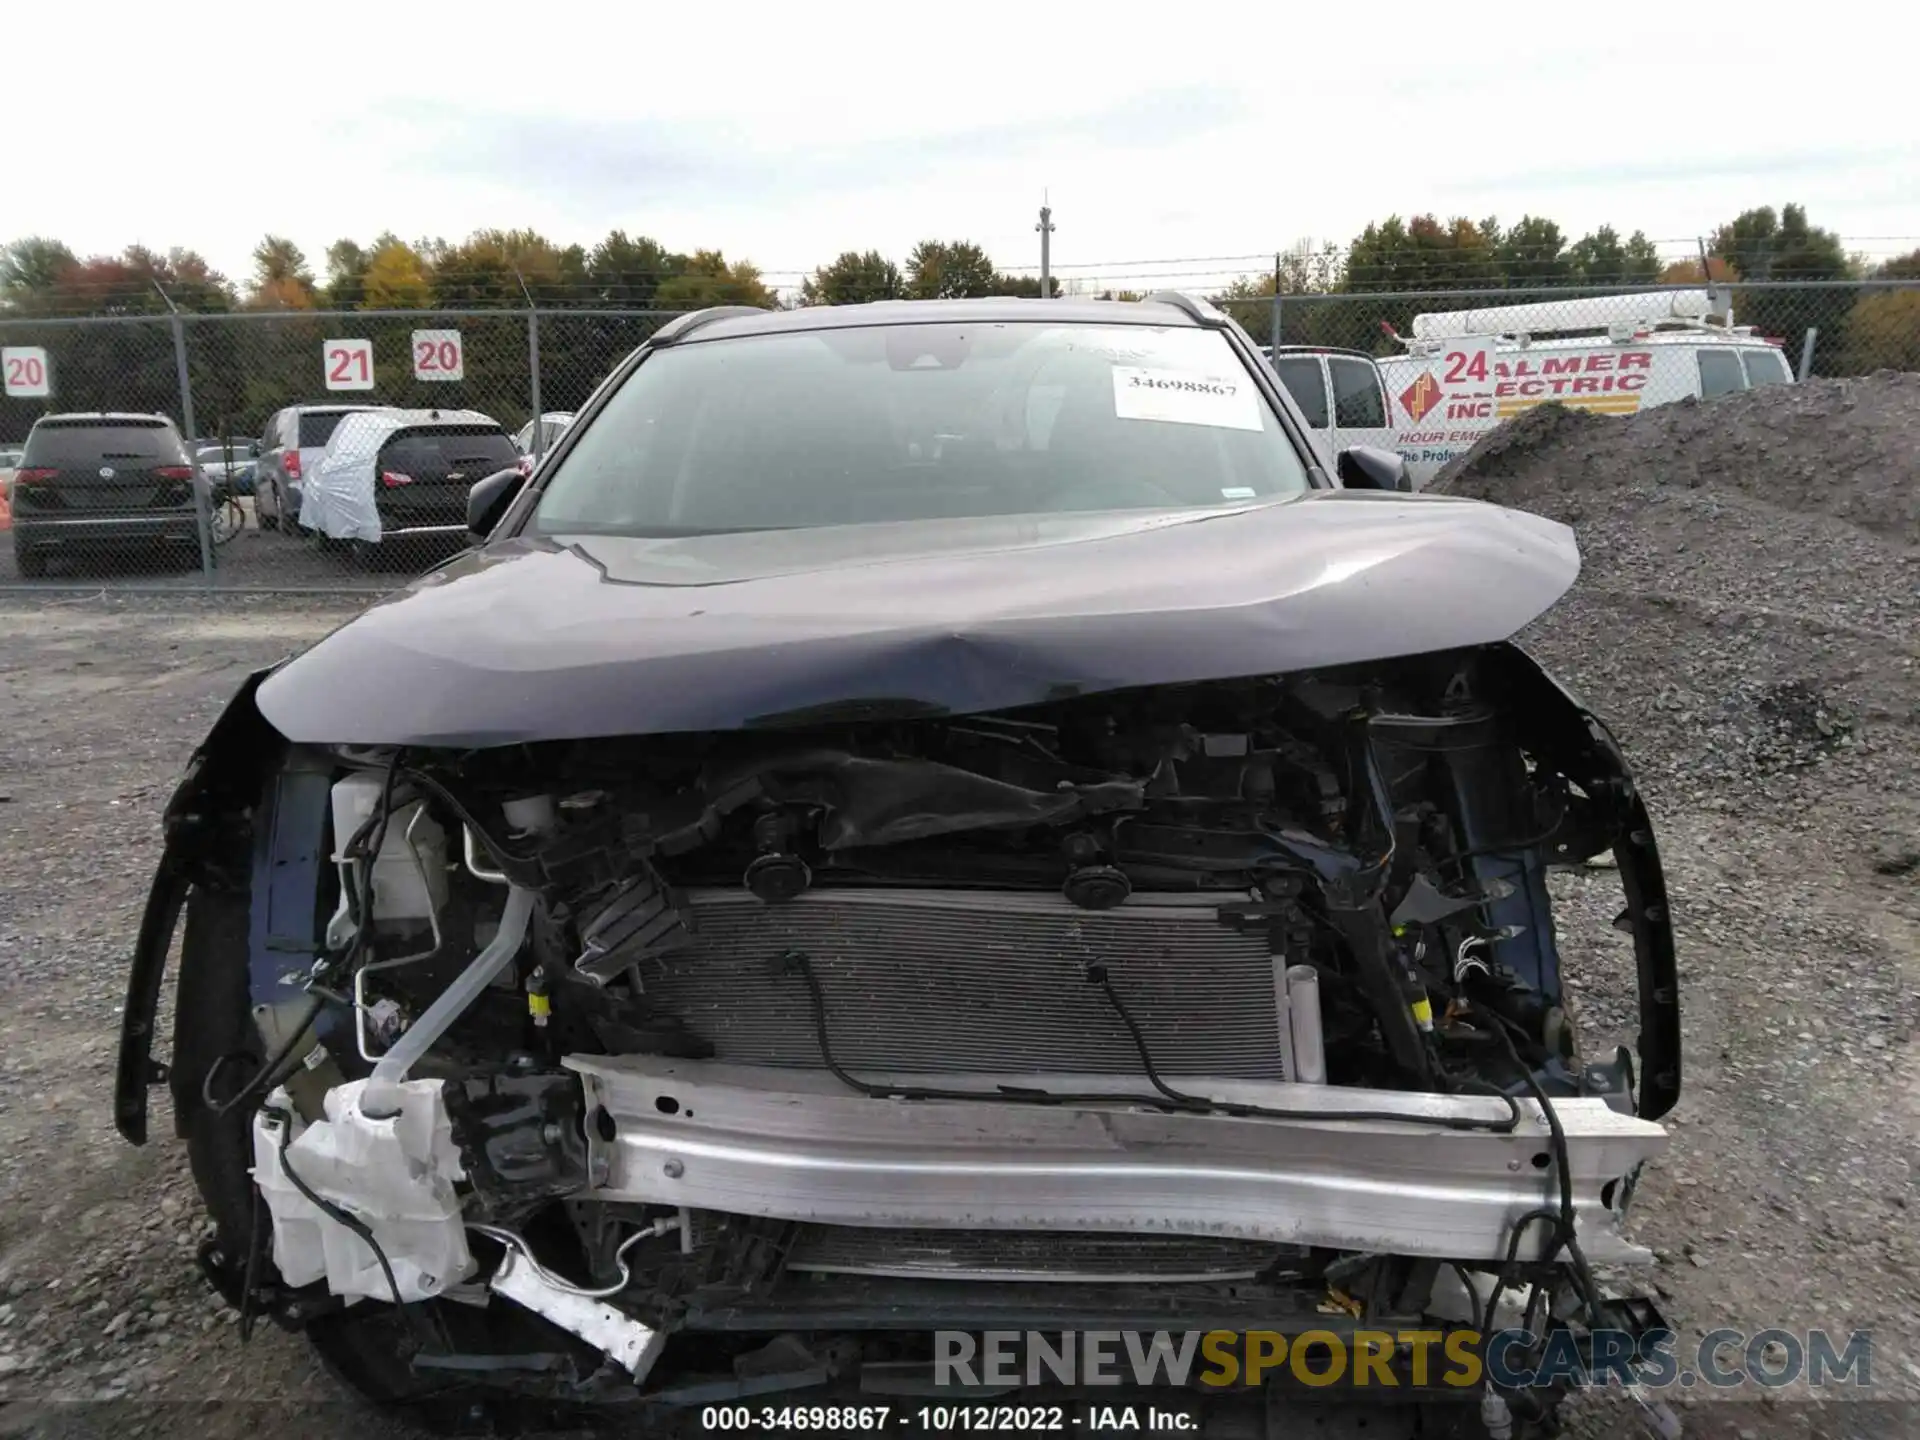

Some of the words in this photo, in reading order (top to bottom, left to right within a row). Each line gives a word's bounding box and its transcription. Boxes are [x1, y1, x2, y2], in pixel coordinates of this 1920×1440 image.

[329, 349, 369, 382] 21
[418, 341, 457, 371] 20
[1443, 350, 1489, 383] 24
[1494, 352, 1652, 377] ALMER
[7, 357, 43, 387] 20
[1127, 375, 1238, 397] 34698867
[1449, 374, 1647, 399] ECTRIC
[1447, 403, 1492, 419] INC
[1398, 431, 1445, 443] HOUR
[1449, 430, 1489, 442] EME
